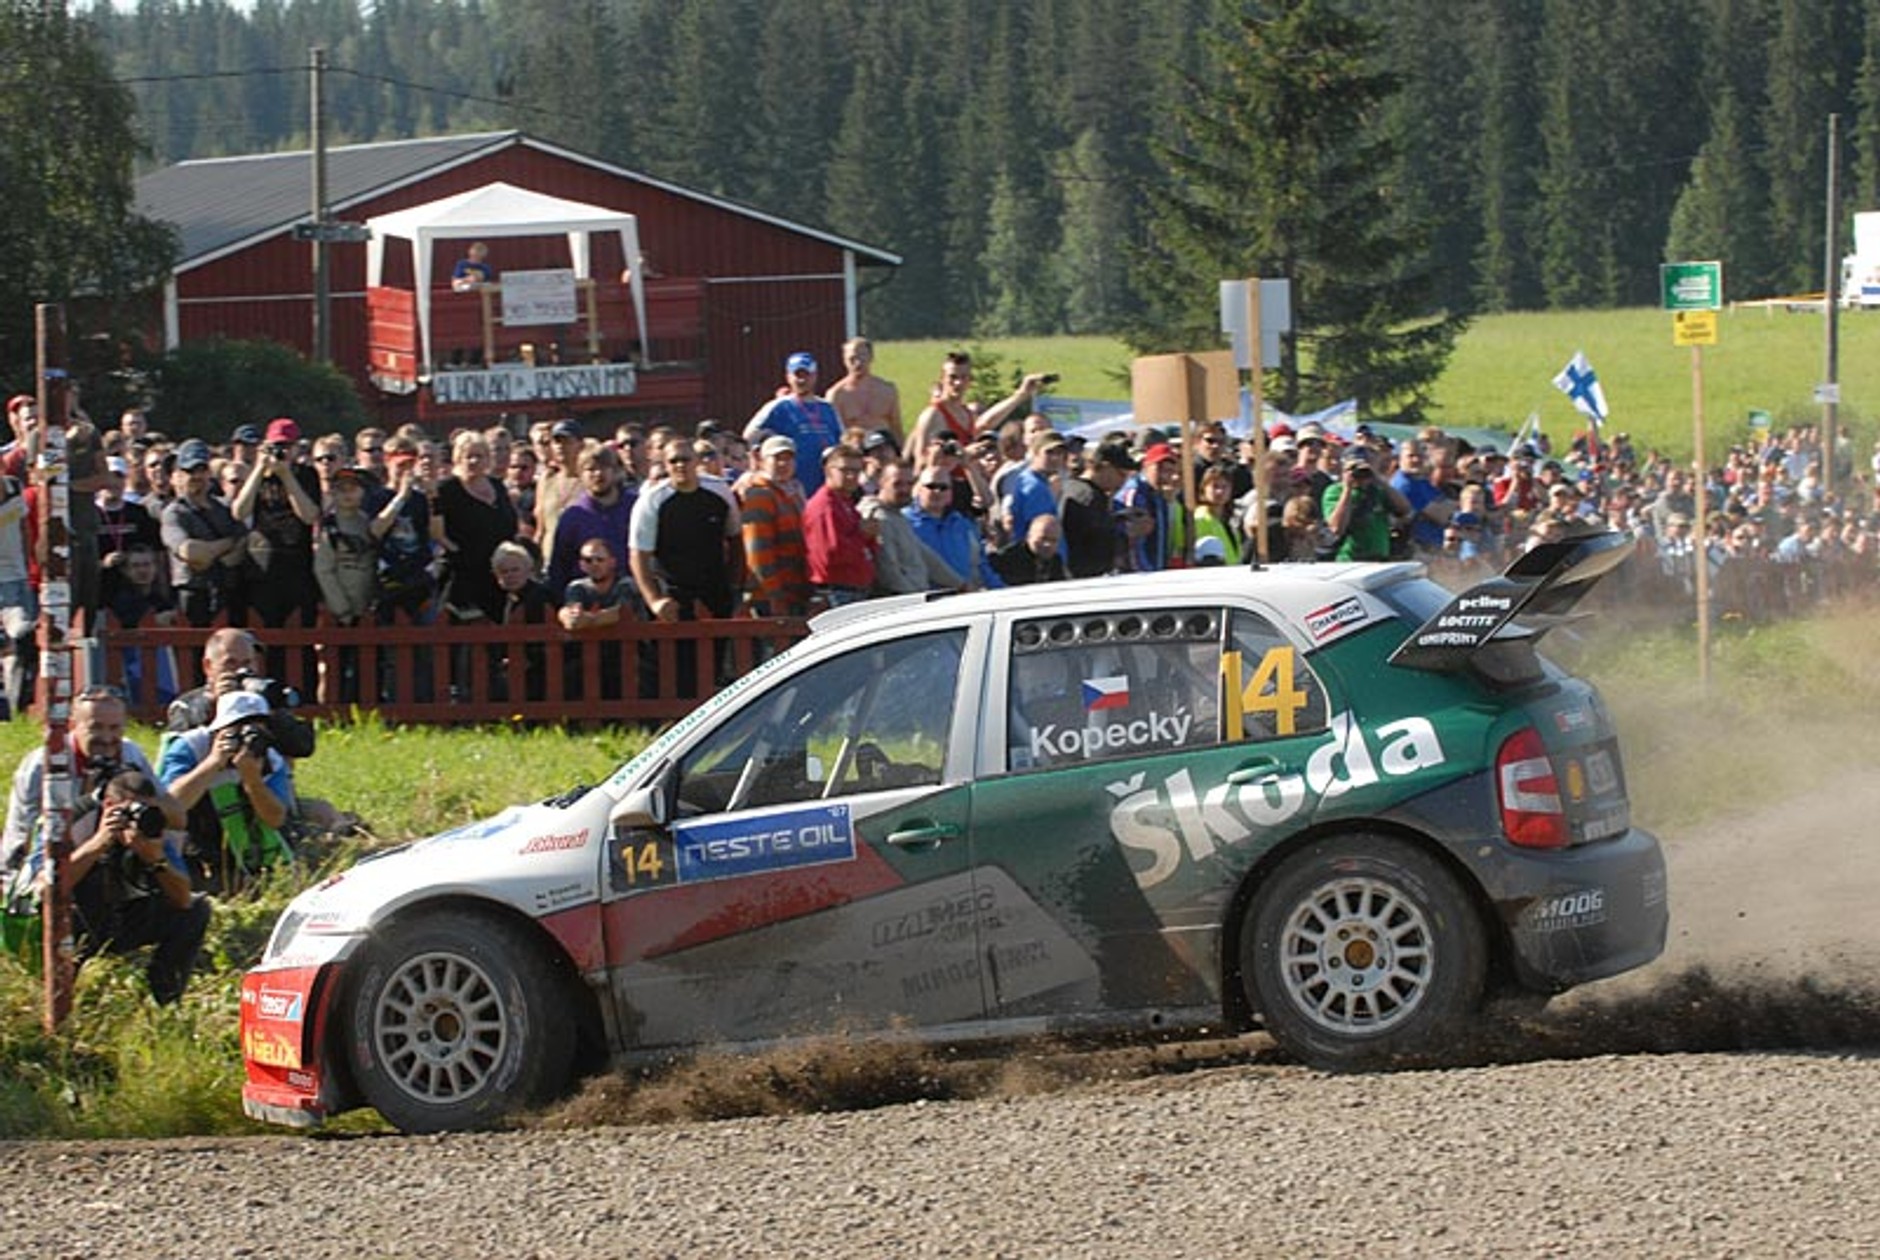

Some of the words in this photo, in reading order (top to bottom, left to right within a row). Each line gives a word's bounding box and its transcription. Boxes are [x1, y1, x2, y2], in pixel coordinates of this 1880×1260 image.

[1222, 646, 1307, 742] 14
[1031, 706, 1193, 758] Kopecký
[1106, 709, 1445, 891] Škoda
[622, 841, 663, 886] 14
[684, 828, 793, 865] NESTE
[799, 824, 847, 848] OIL
